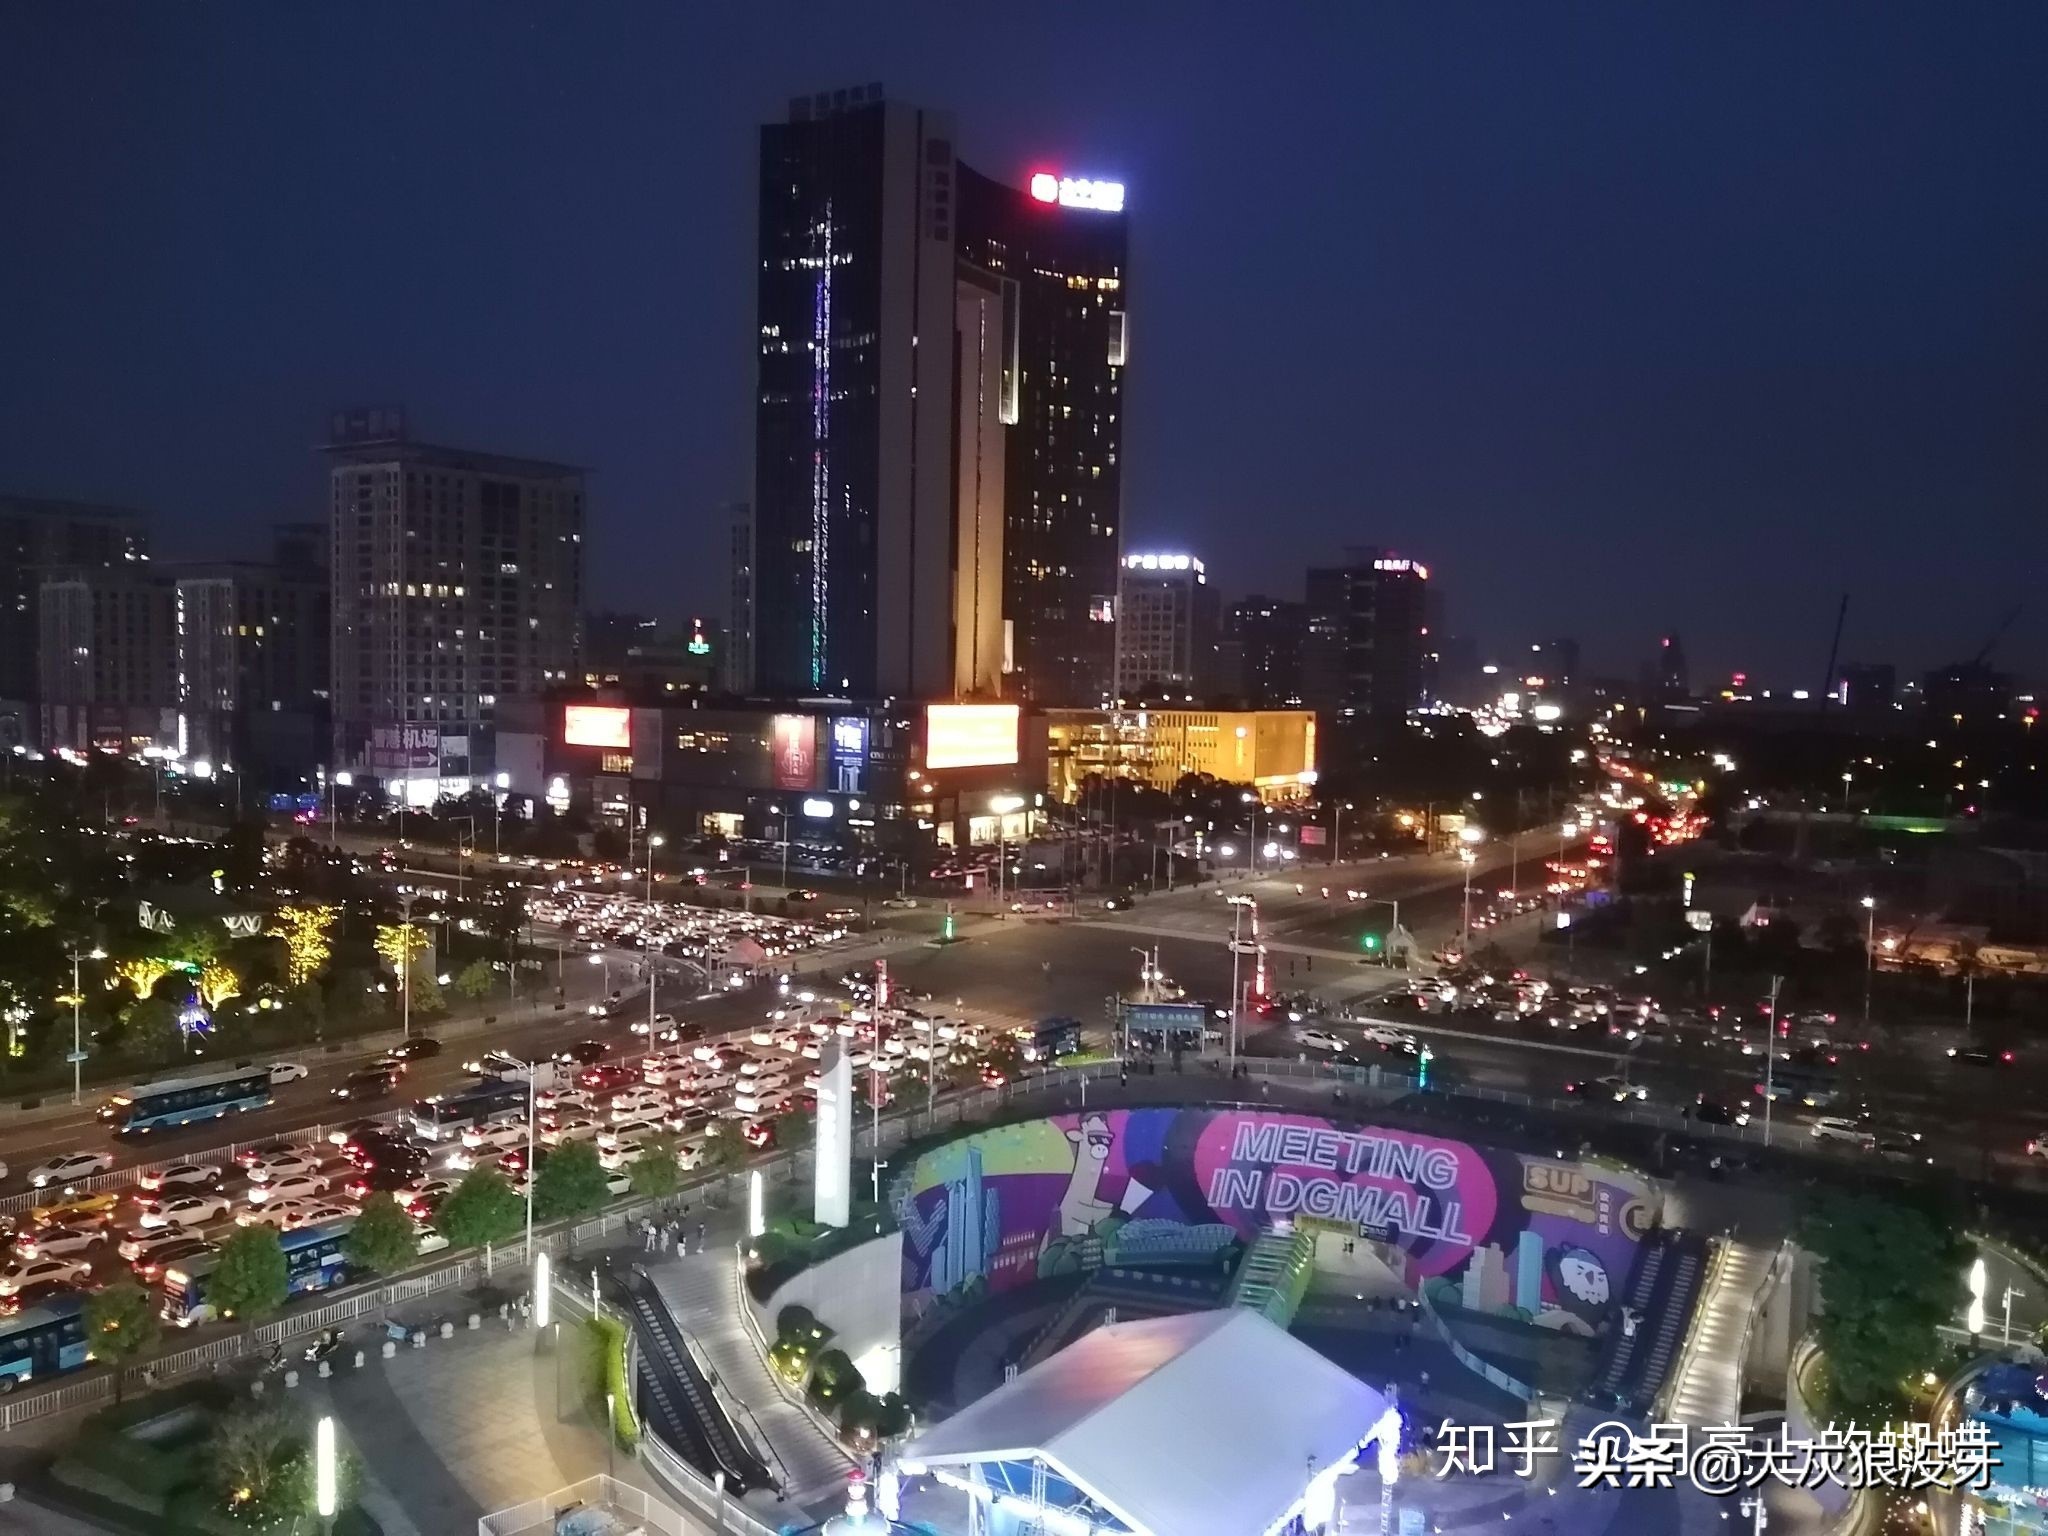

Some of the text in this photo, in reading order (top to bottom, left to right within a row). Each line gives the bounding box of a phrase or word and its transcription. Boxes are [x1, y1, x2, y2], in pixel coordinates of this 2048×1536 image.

[1231, 1121, 1458, 1189] MEETING
[1207, 1168, 1472, 1245] IN DGMALL
